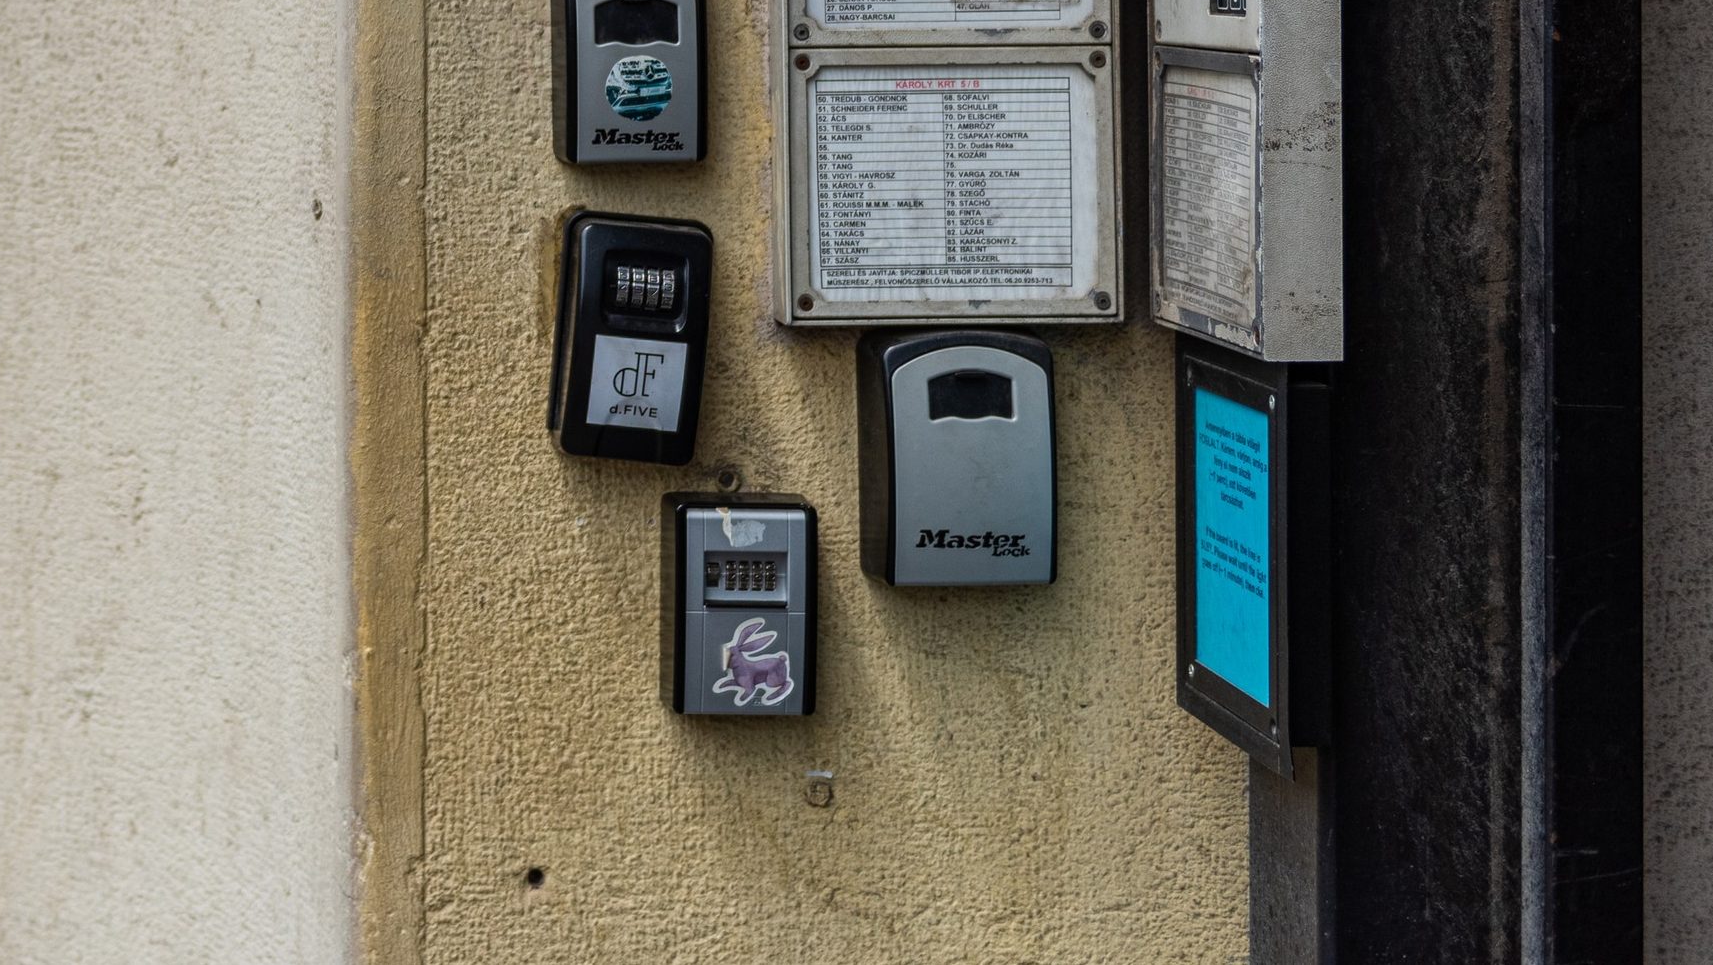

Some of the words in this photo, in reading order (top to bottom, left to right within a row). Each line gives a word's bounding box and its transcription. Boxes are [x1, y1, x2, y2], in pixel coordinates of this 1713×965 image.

[937, 80, 956, 89] KRT
[592, 128, 681, 145] Master
[652, 141, 684, 151] Lock
[609, 404, 658, 418] d.FIVE
[915, 529, 1026, 549] Master
[991, 545, 1031, 557] Lock
